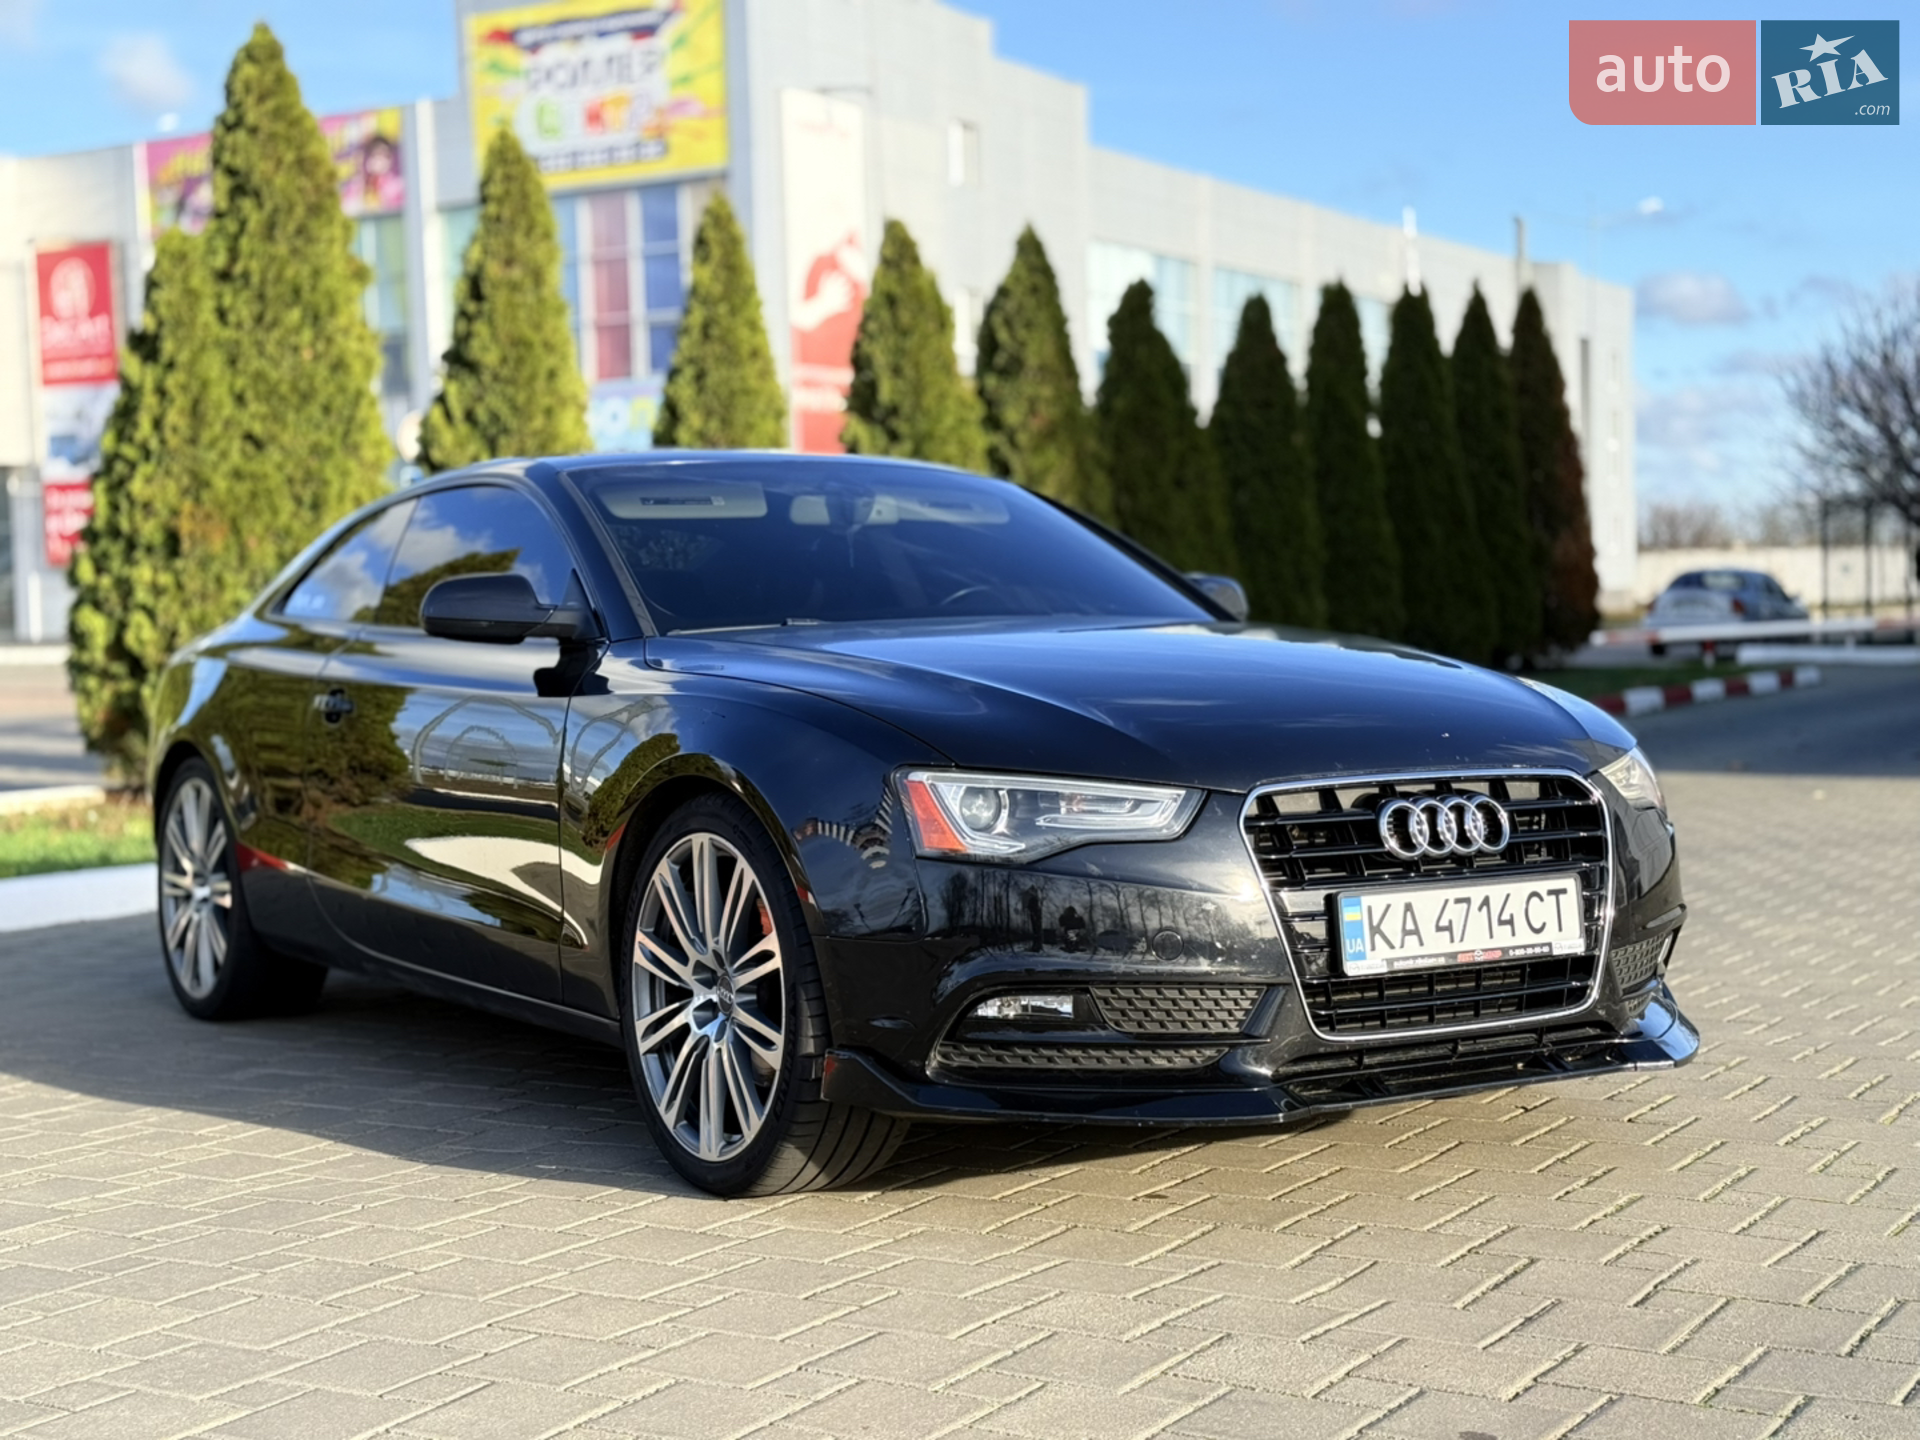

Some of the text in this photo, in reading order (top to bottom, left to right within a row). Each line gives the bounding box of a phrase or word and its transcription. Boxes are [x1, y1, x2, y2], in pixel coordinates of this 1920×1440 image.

[1367, 888, 1568, 951] KA 4714 CT
[1346, 937, 1364, 953] UA
